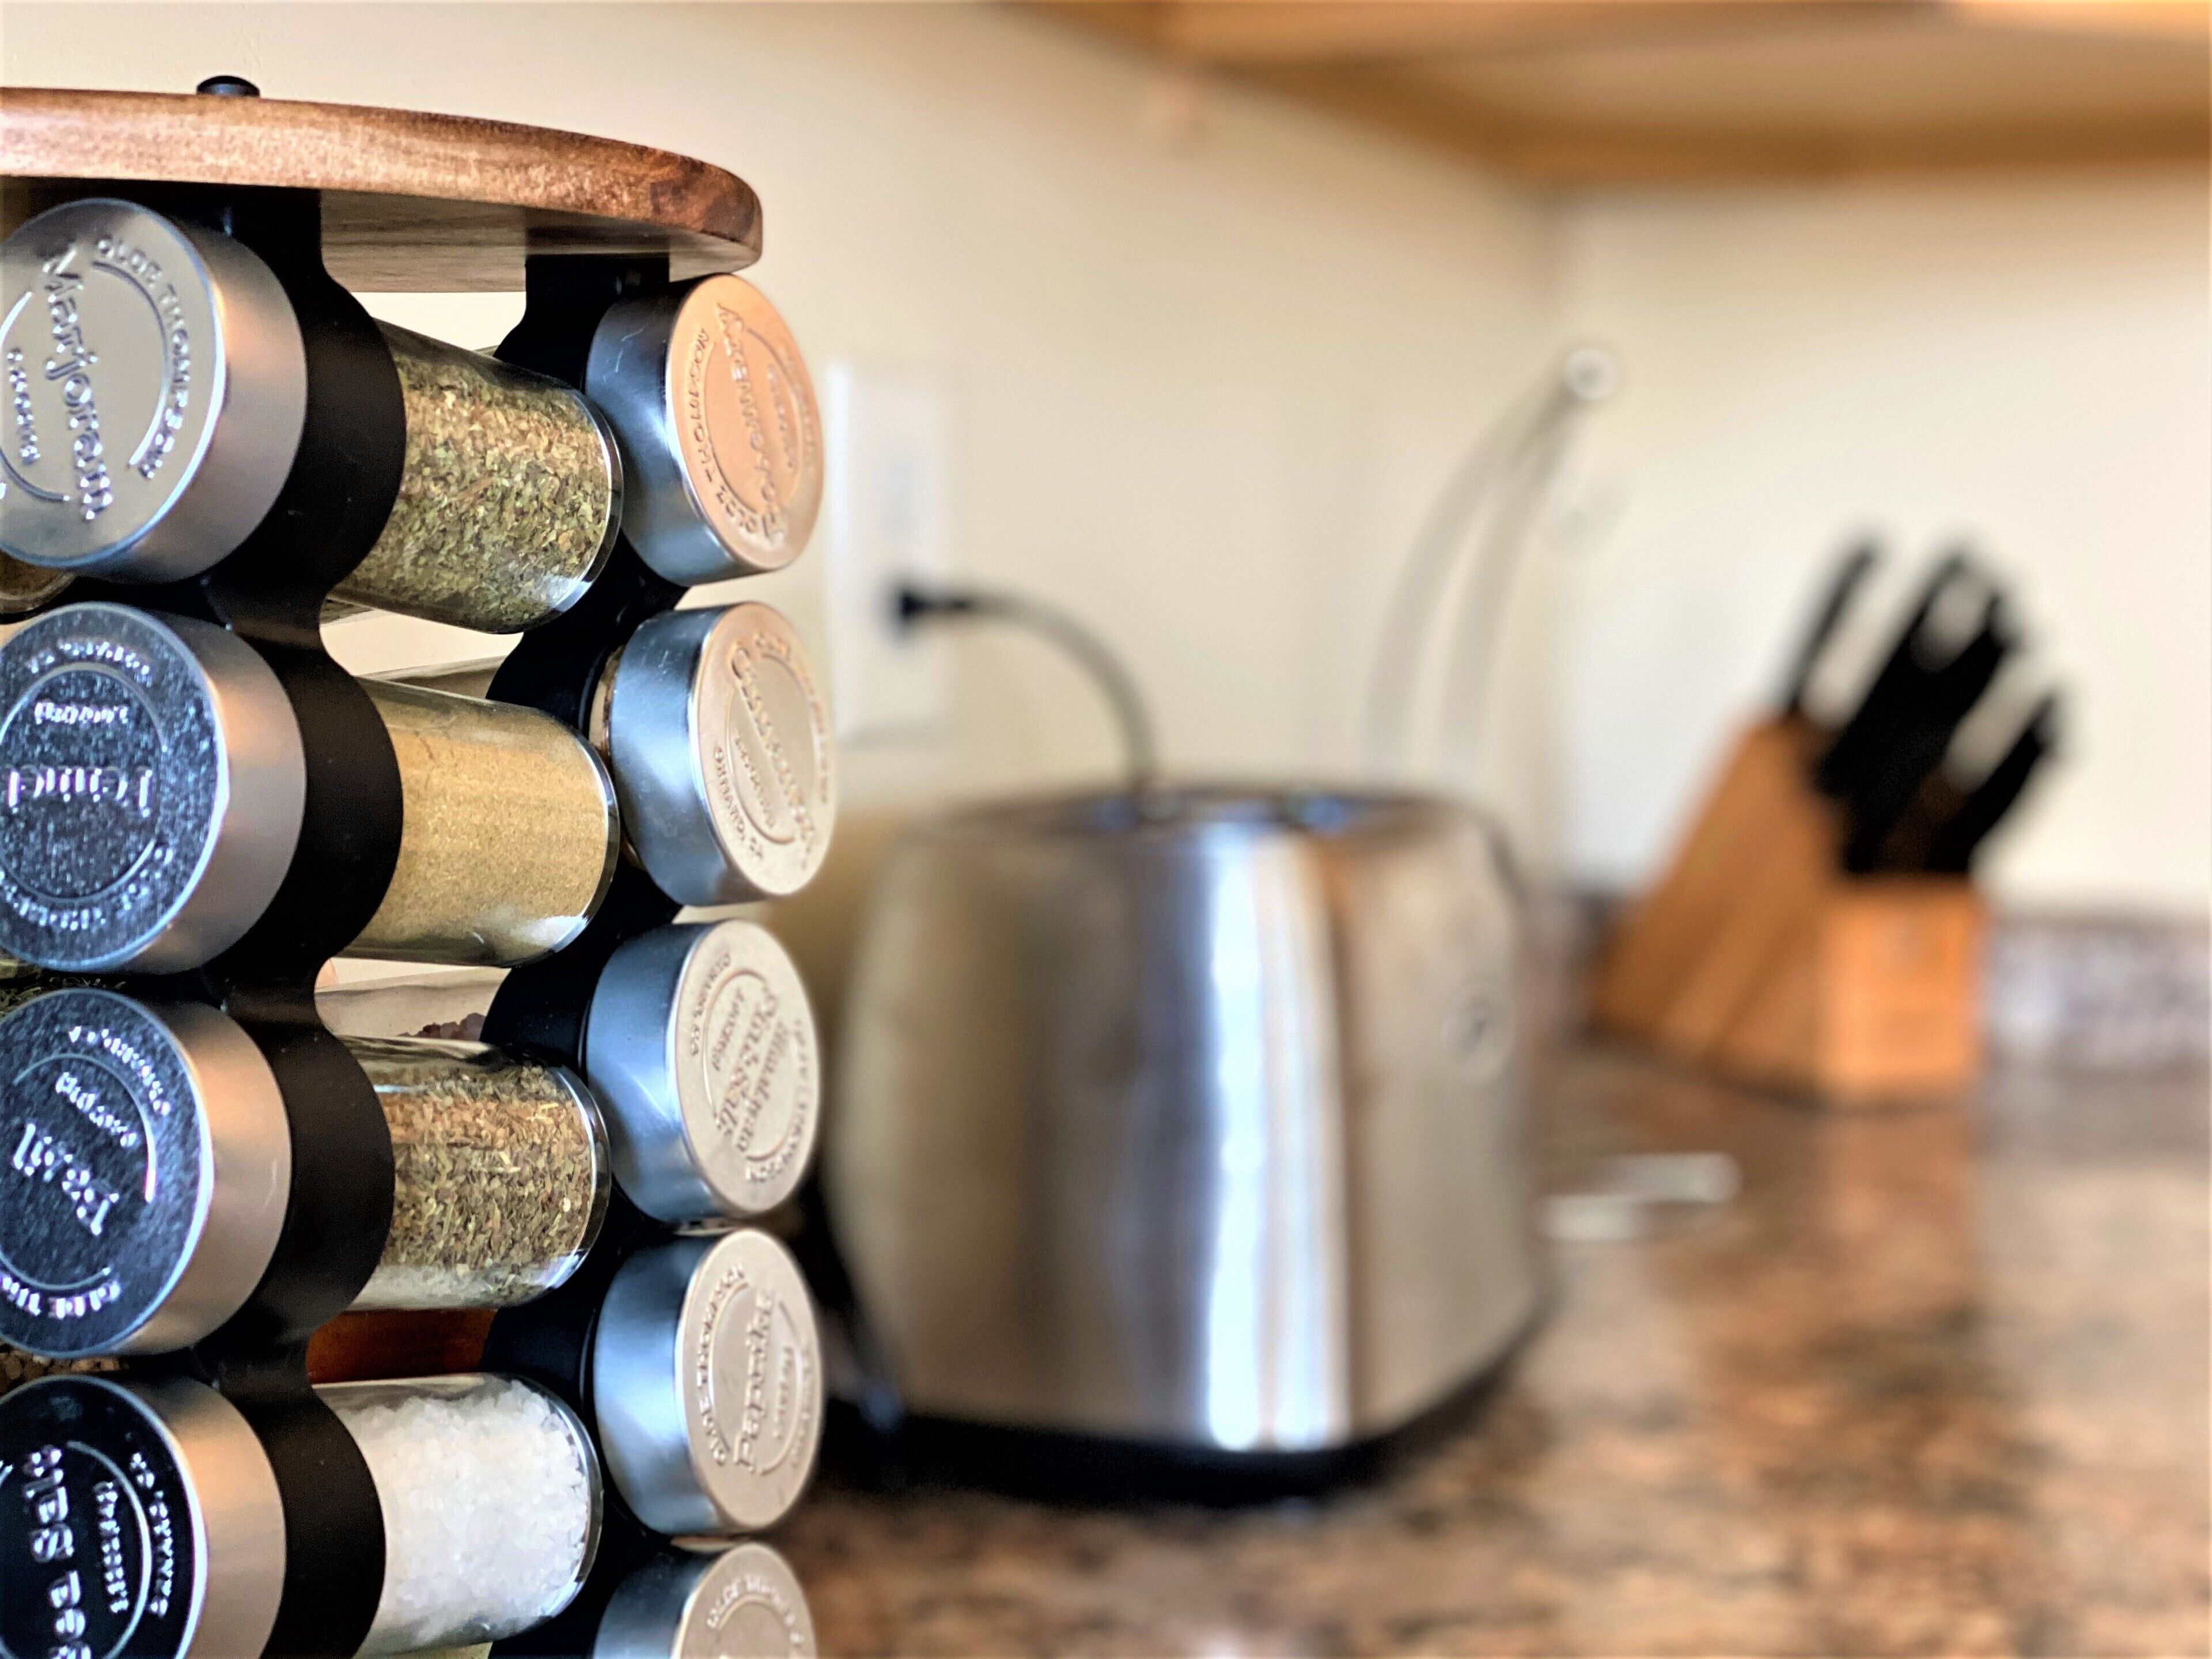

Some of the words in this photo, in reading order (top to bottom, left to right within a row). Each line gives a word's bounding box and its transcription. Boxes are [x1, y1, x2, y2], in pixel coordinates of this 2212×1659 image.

[43, 247, 113, 520] Marjoram
[13, 1122, 119, 1237] Basil
[733, 1289, 775, 1474] Paprika
[23, 1444, 75, 1564] Salt
